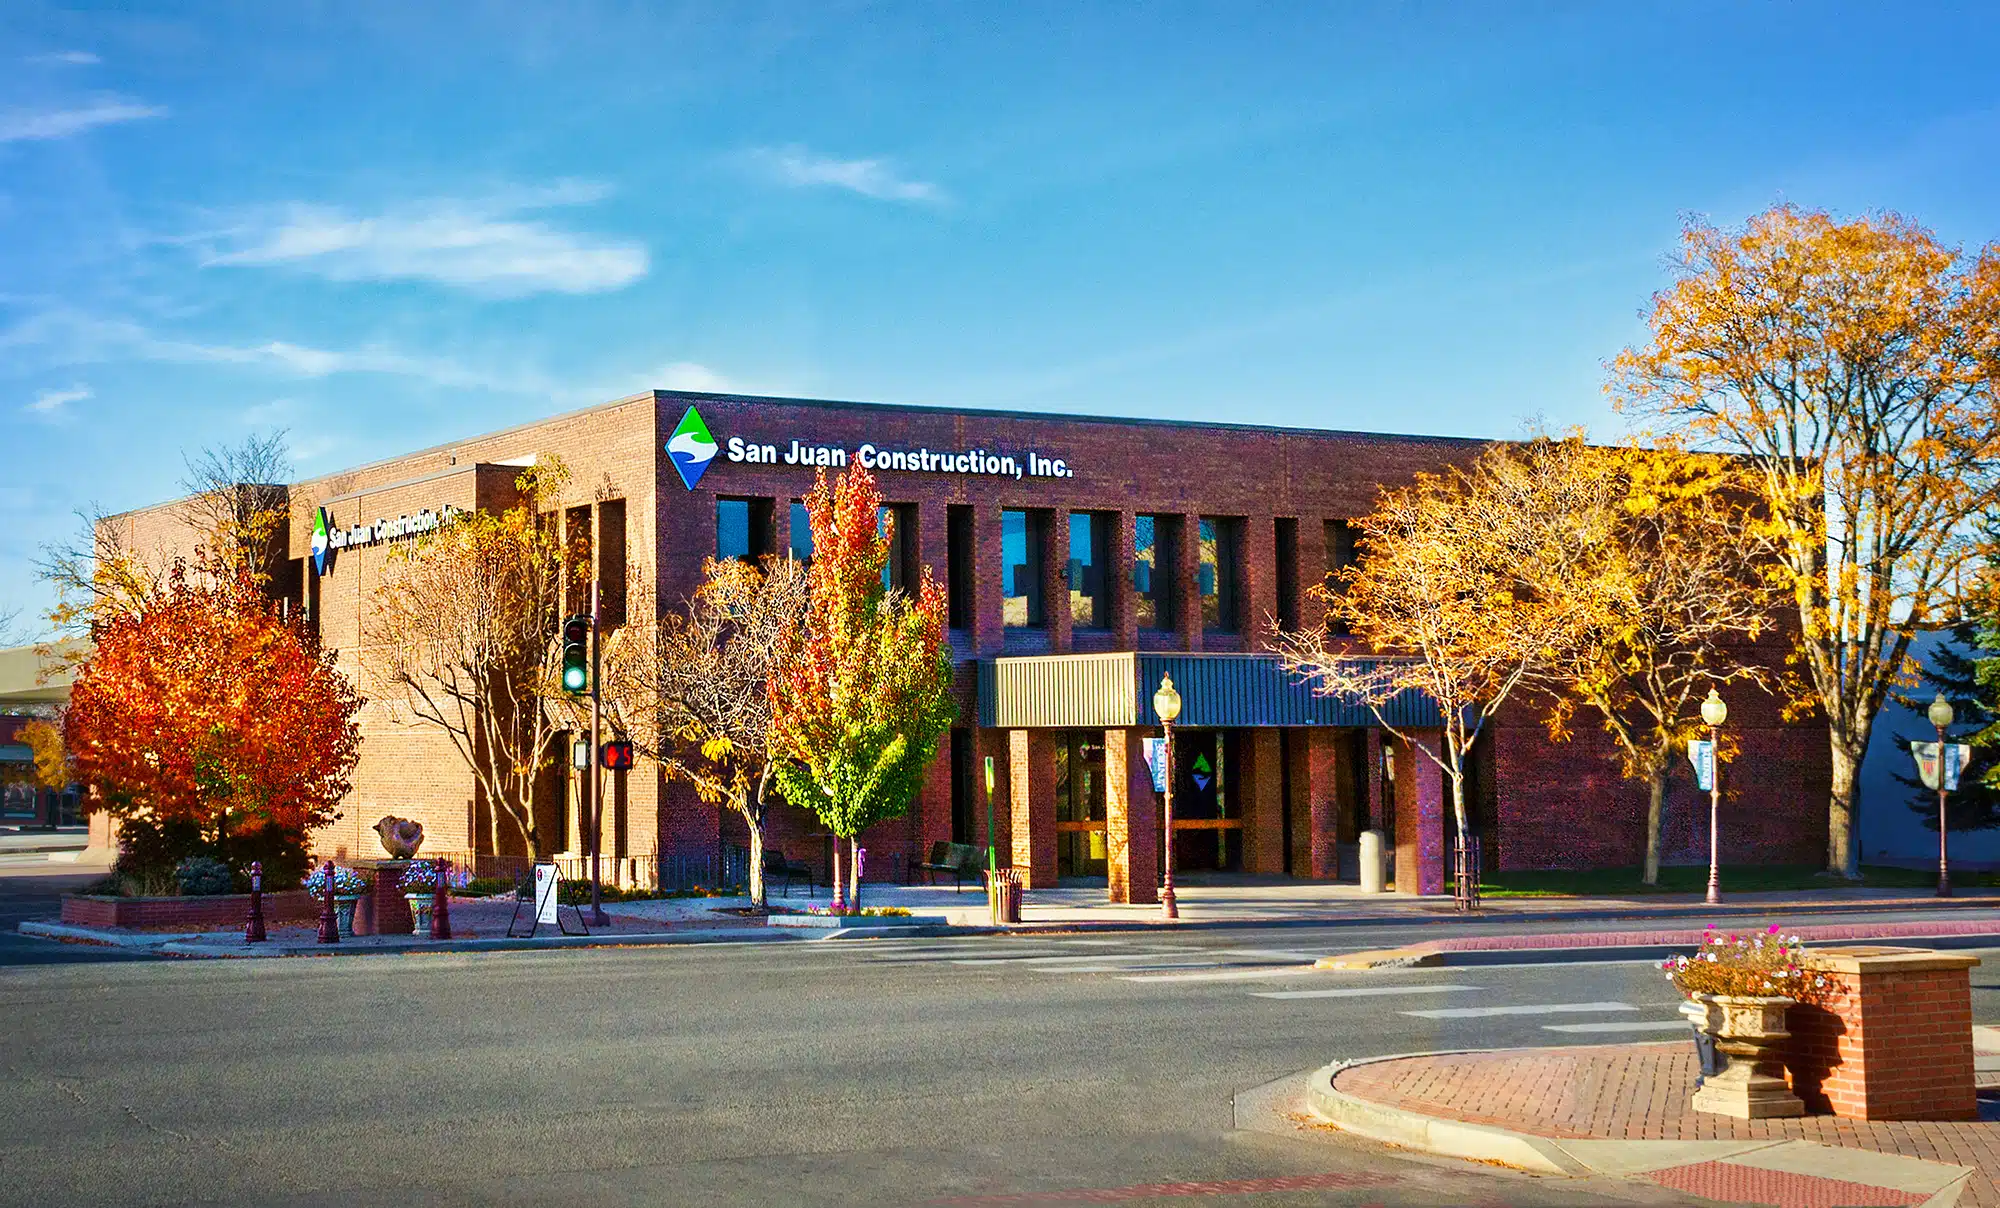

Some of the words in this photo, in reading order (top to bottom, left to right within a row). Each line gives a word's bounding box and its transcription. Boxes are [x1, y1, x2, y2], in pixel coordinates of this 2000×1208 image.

[727, 436, 777, 464] San
[784, 440, 846, 467] Juan
[859, 443, 1023, 480] Construction,
[1029, 452, 1073, 478] Inc.
[329, 527, 348, 549] San
[348, 523, 372, 546] Juan
[623, 746, 631, 765] 5
